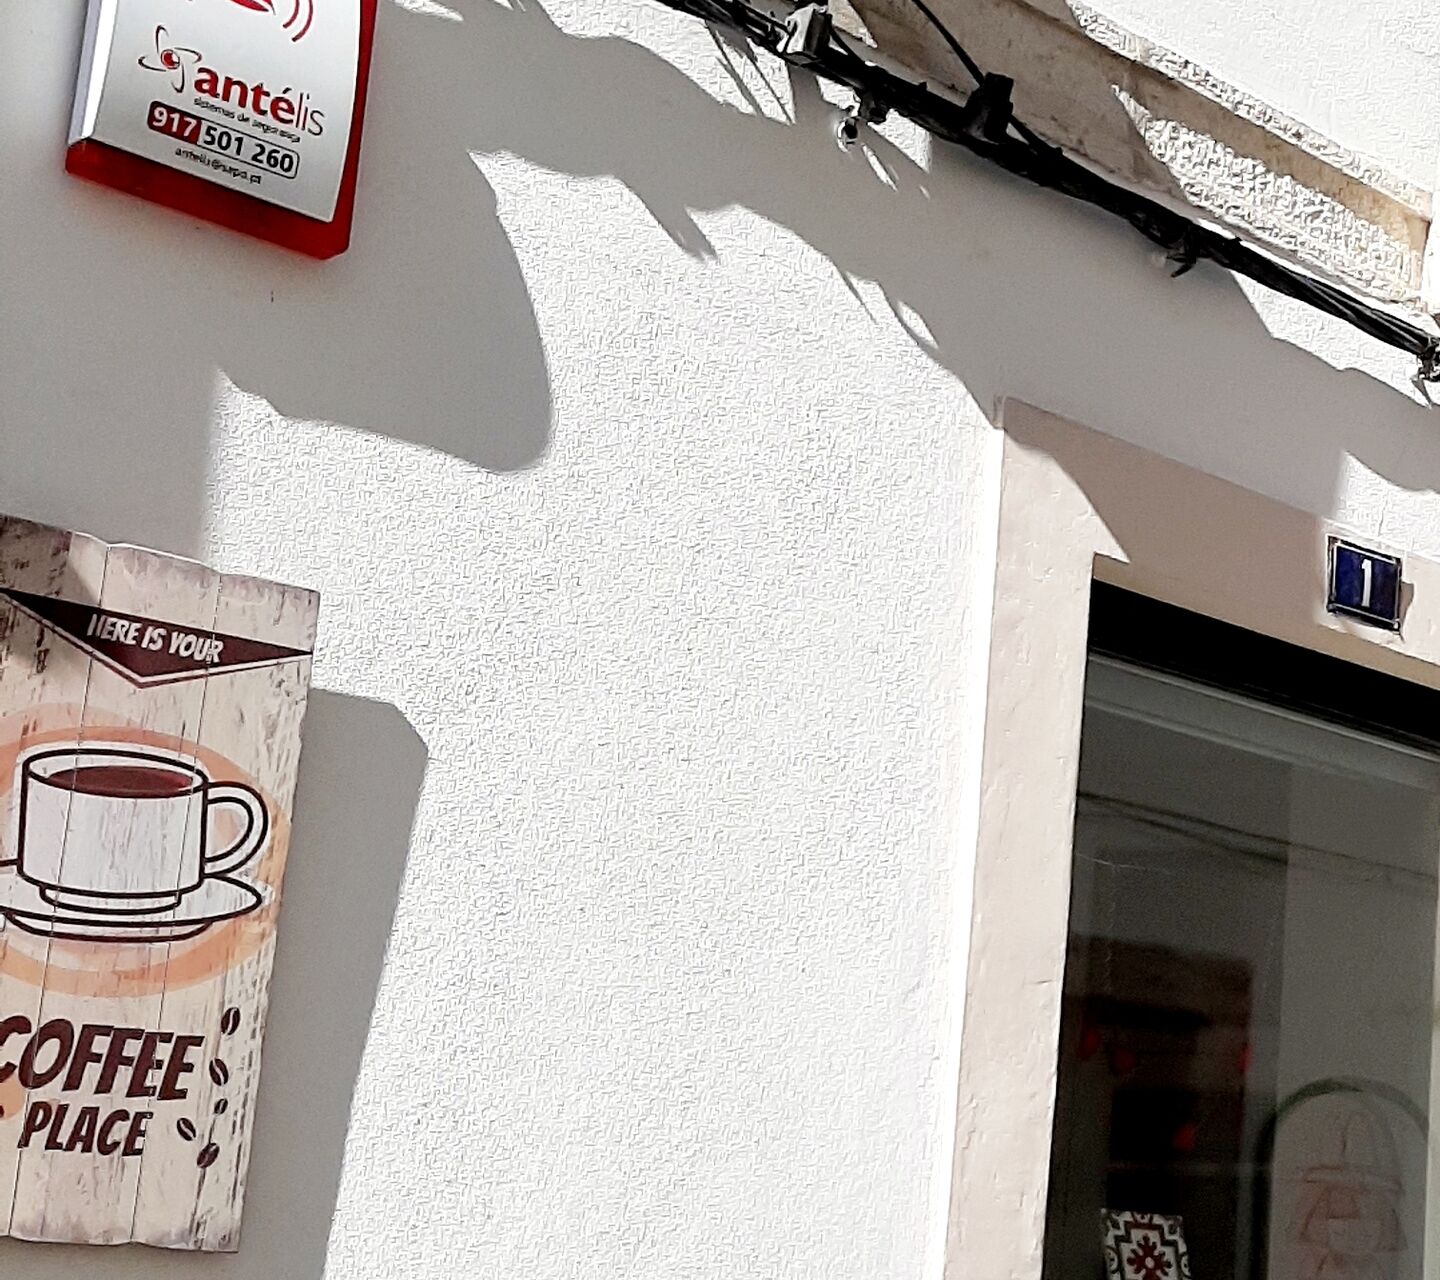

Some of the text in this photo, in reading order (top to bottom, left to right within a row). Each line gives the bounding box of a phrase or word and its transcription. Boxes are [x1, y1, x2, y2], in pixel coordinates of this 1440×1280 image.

[152, 106, 294, 173] 917 501 260
[1361, 558, 1373, 608] 1
[86, 613, 224, 664] HERE IS YOUR
[0, 1015, 205, 1101] COFFEE
[17, 1100, 154, 1157] PLACE
